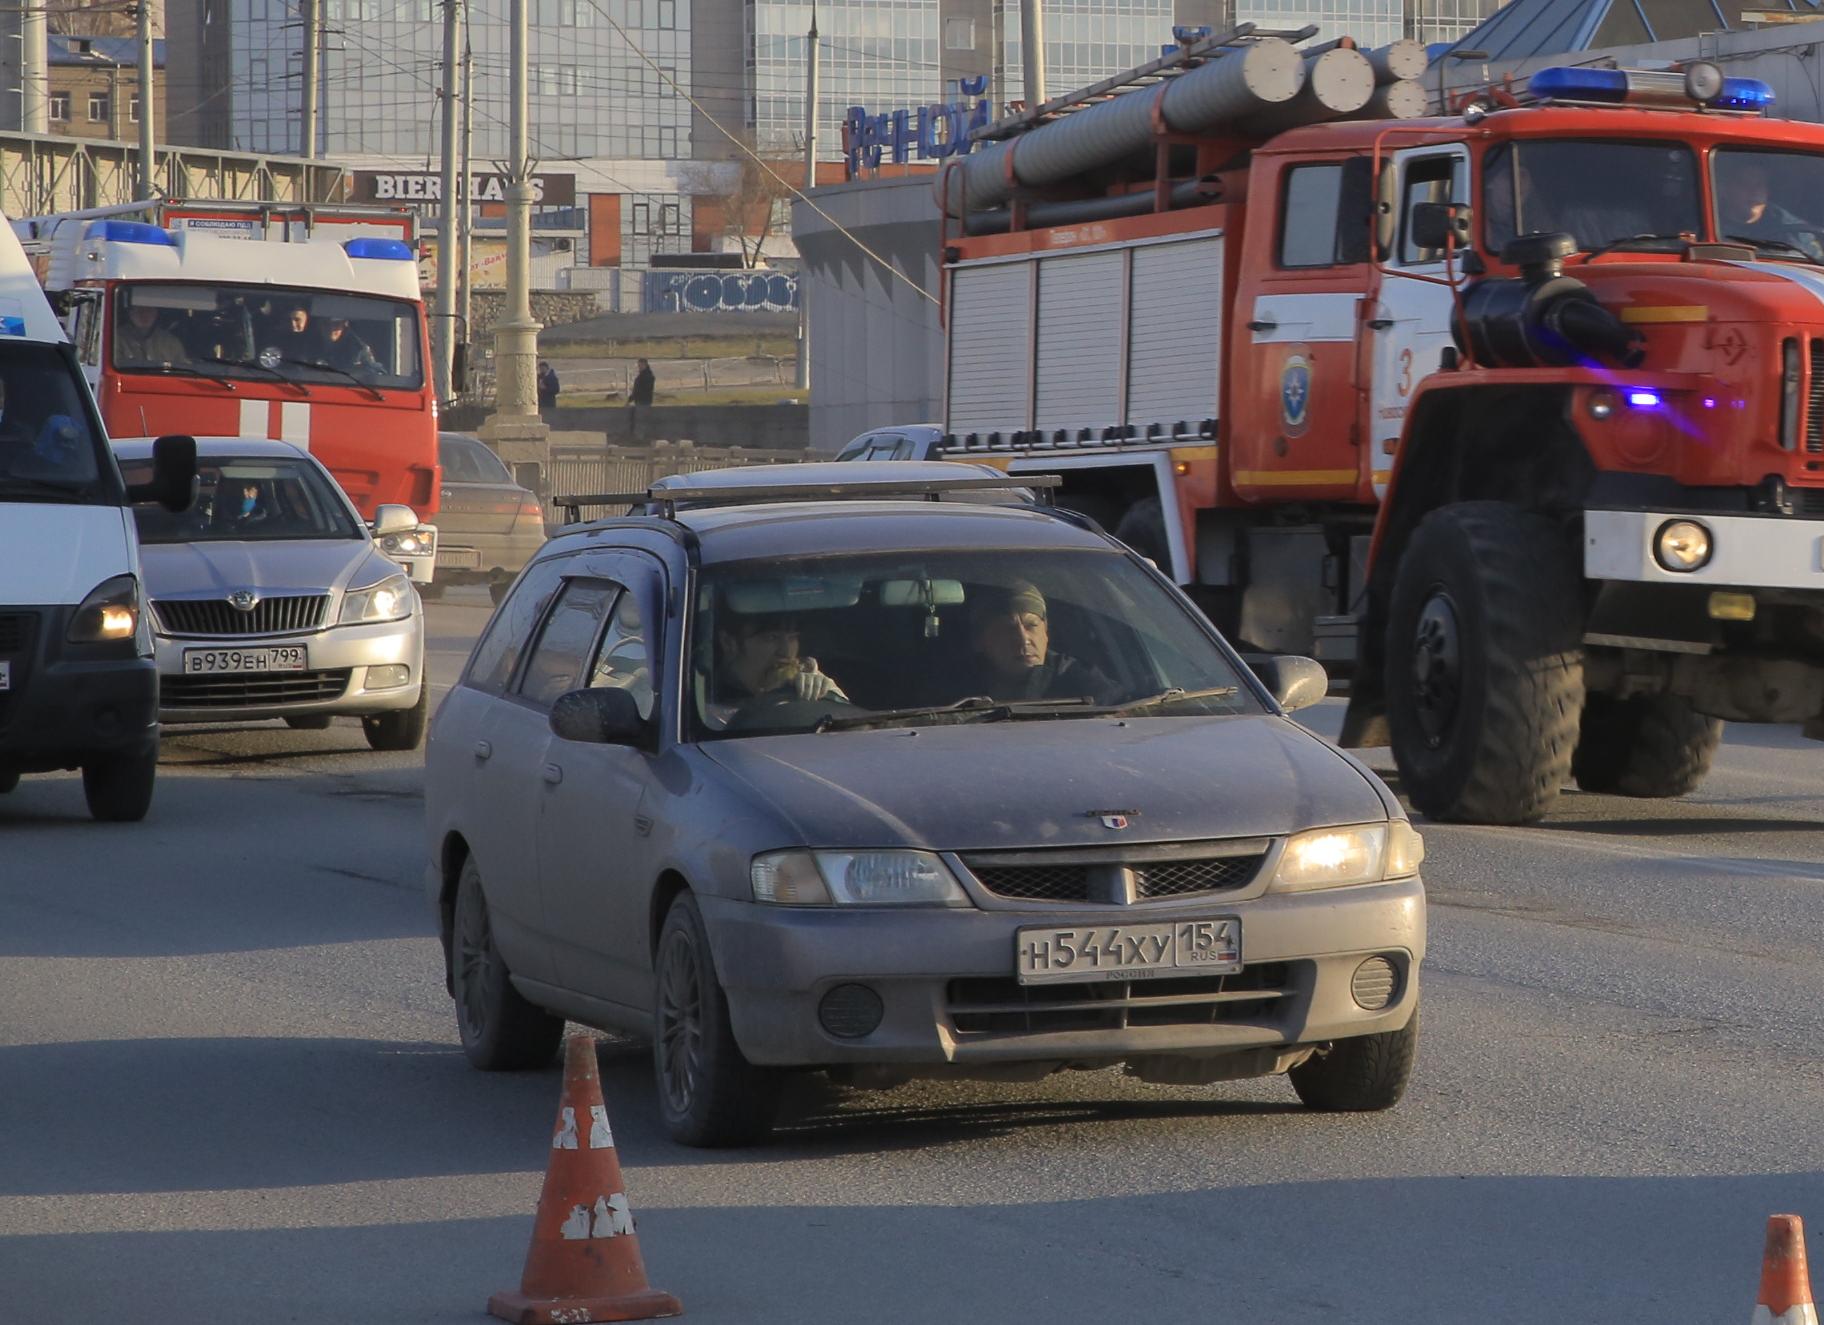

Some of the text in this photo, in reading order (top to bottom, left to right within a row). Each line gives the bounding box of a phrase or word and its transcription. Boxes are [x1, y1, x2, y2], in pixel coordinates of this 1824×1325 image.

[1397, 348, 1412, 398] 3
[192, 648, 299, 671] В939ЕН 799
[1030, 922, 1234, 969] Н544ХУ 154
[1191, 951, 1217, 962] RUS
